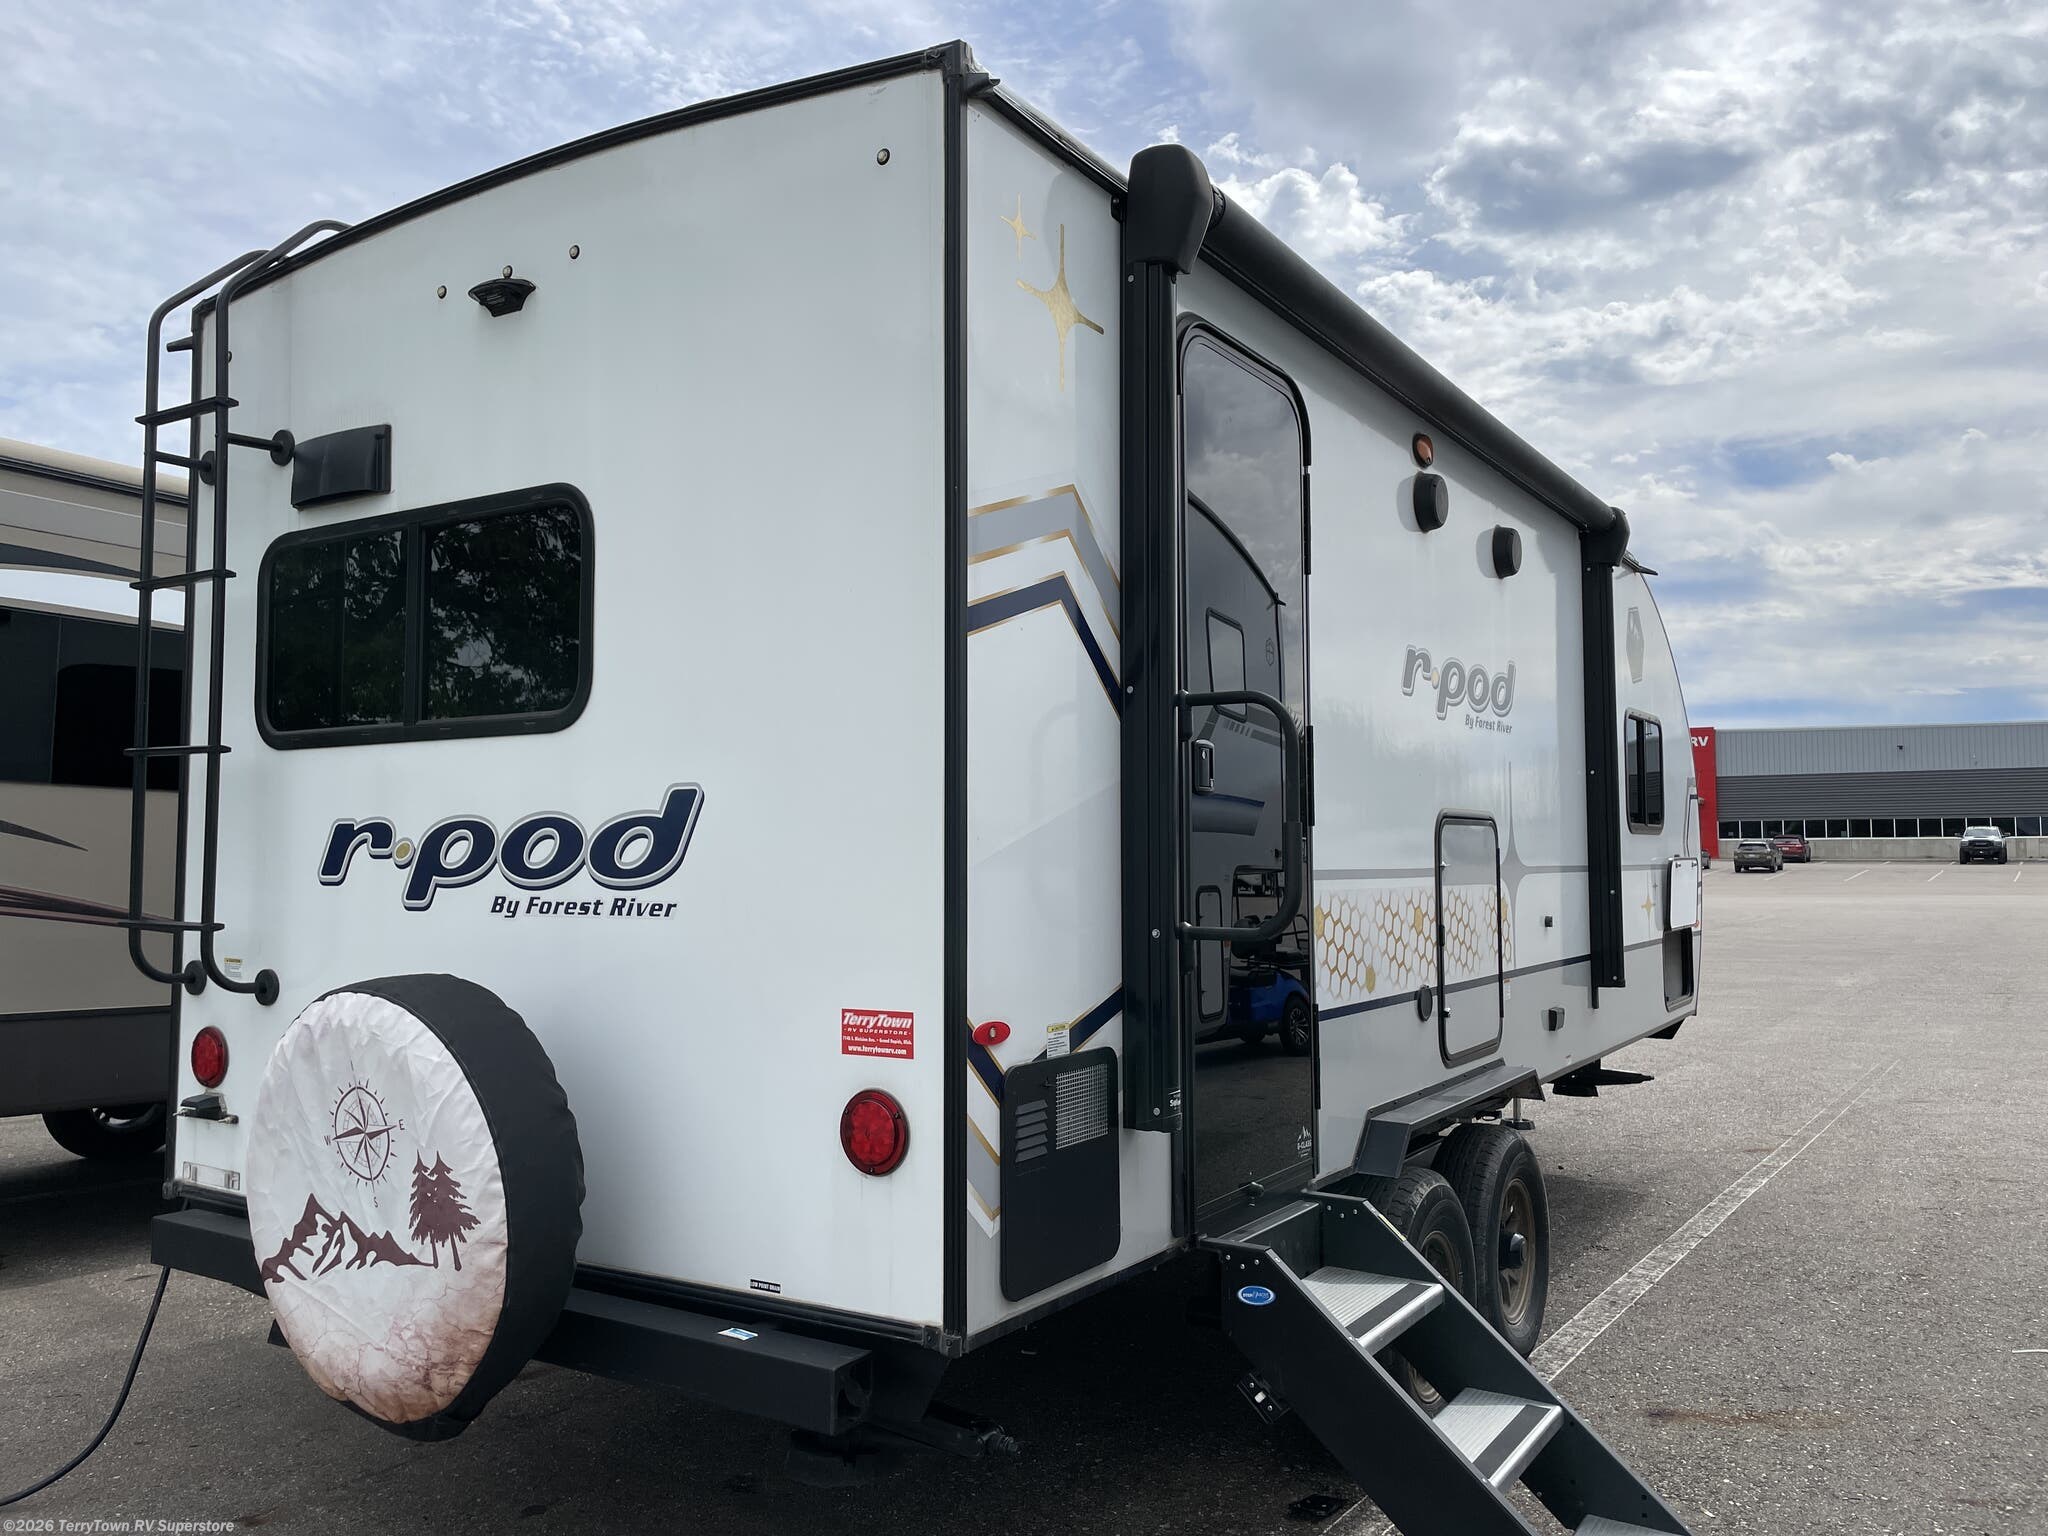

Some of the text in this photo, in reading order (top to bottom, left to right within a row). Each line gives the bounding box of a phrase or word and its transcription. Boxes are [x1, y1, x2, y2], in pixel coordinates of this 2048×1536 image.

[1465, 714, 1513, 734] By Forest River
[1691, 735, 1709, 747] RV
[490, 896, 678, 919] By Forest River
[842, 1012, 913, 1029] TerryTown
[859, 1028, 908, 1036] SUPERSTORE
[398, 1119, 406, 1131] E
[323, 1135, 332, 1146] W
[373, 1196, 379, 1208] S
